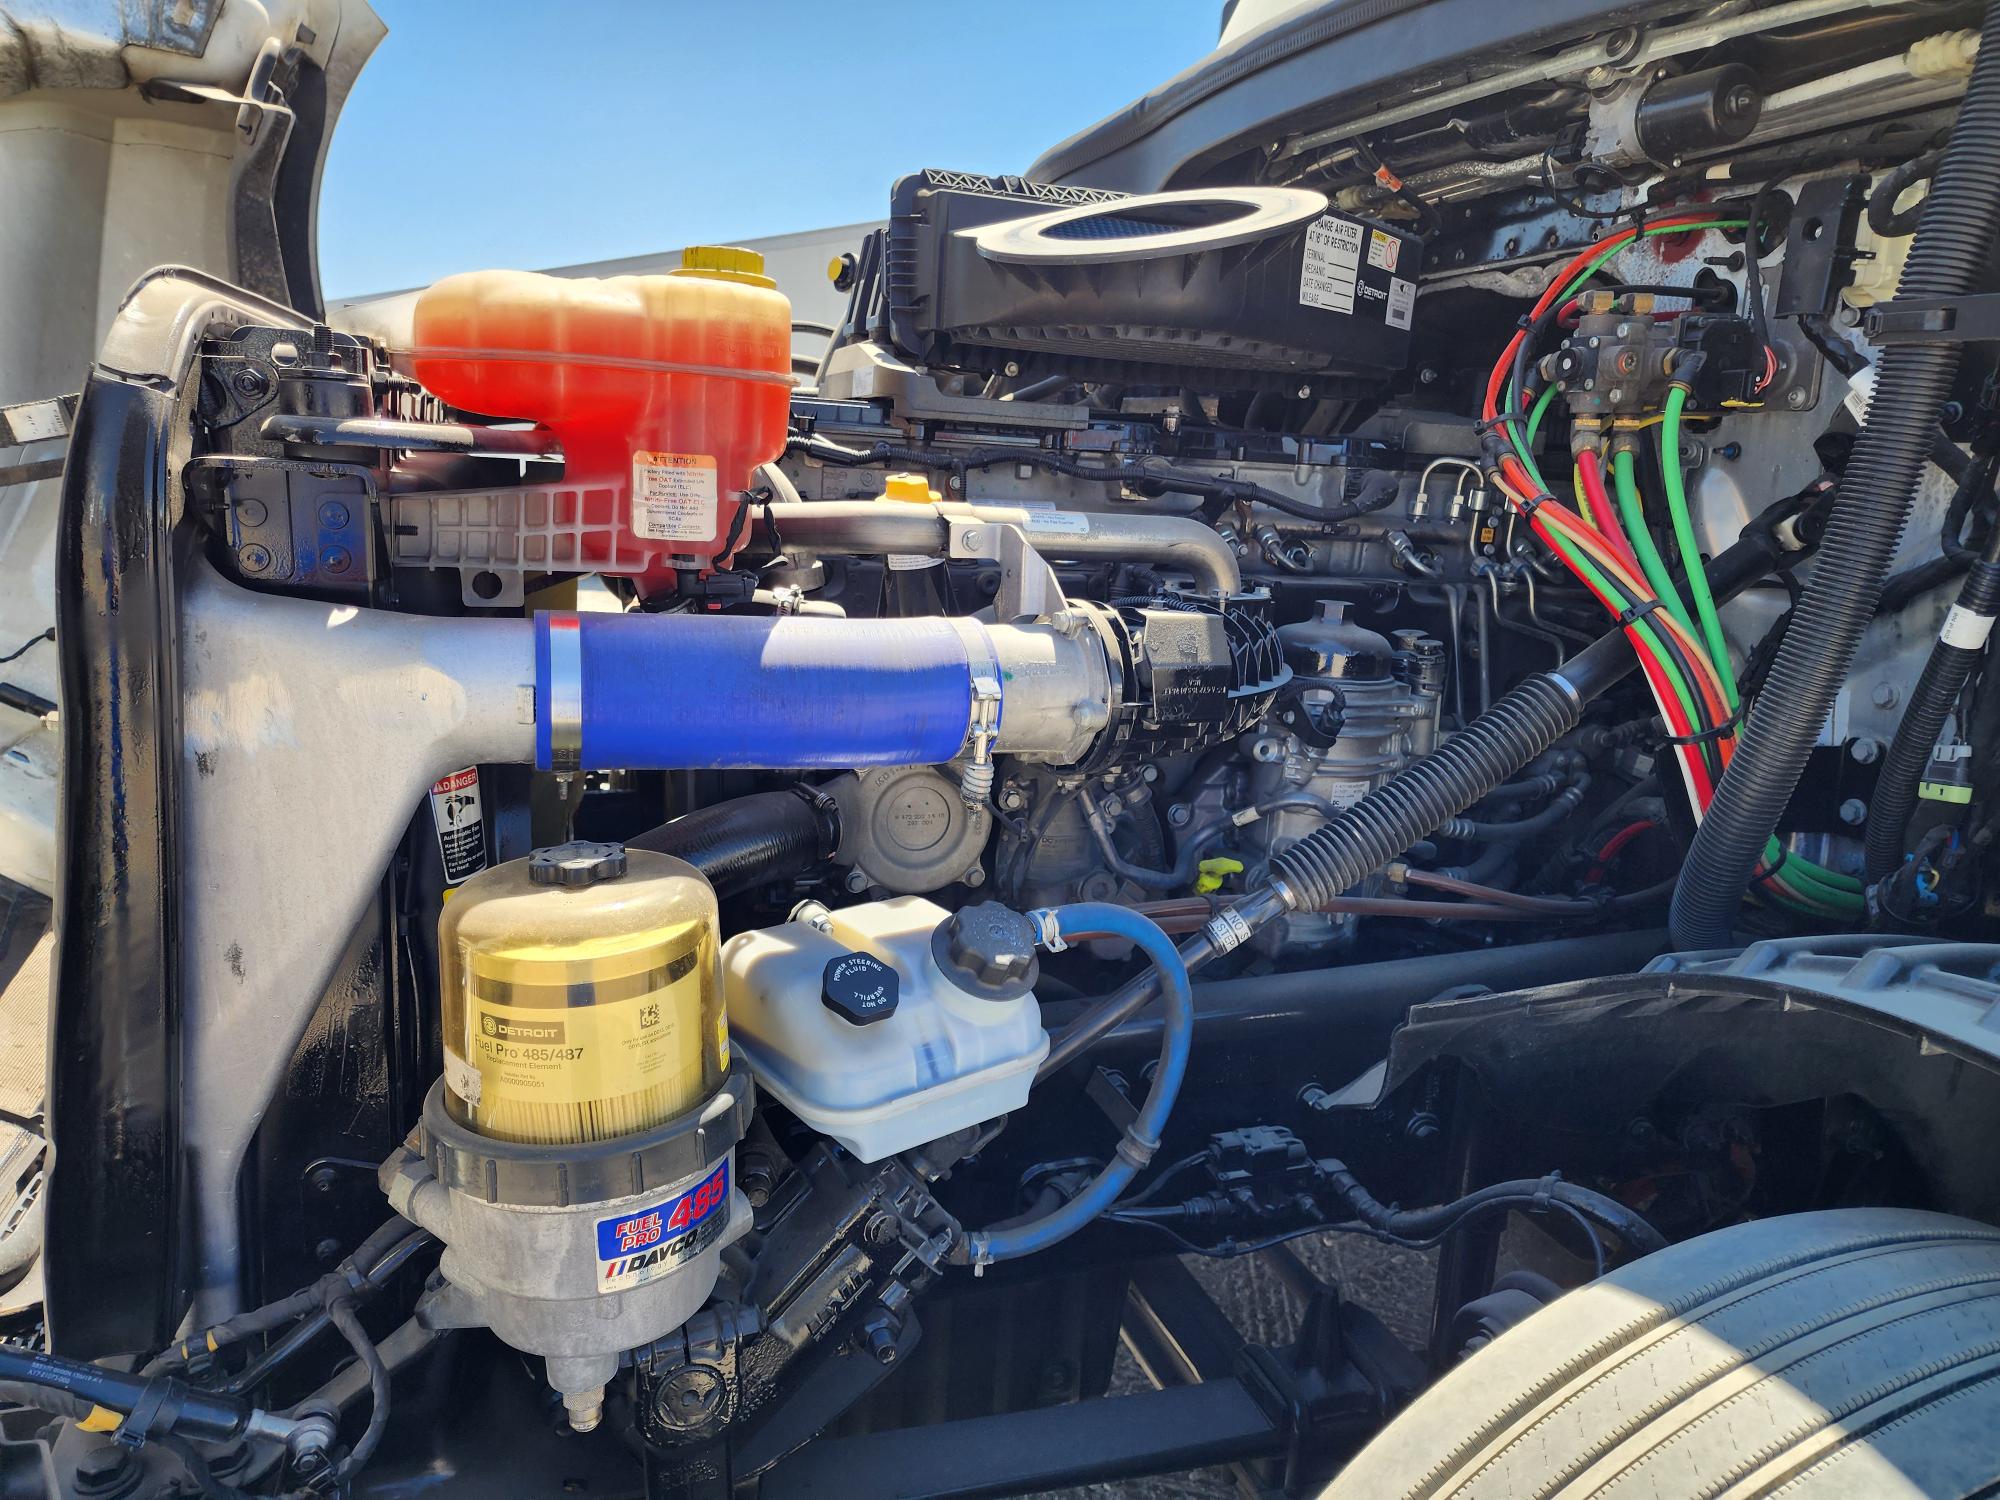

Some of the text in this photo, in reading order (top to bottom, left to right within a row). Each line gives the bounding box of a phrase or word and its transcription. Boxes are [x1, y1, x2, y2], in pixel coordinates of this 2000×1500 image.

[1335, 224, 1344, 234] AIR
[1344, 225, 1358, 239] FILTER
[1331, 237, 1359, 253] RESTRICTION
[1303, 277, 1313, 288] DATE
[1364, 286, 1388, 300] DETROIT
[443, 772, 477, 790] DANGER
[1229, 915, 1244, 930] NO
[1217, 923, 1236, 947] STEP
[833, 958, 883, 982] POWER STEERING
[845, 966, 867, 976] FLUID
[854, 986, 884, 1001] OVERFILL
[878, 996, 887, 1005] DO
[498, 1024, 558, 1038] DETROIT
[475, 1035, 584, 1061] Fuel Pro 485/487
[667, 1168, 724, 1232] 485
[616, 1212, 662, 1238] FUEL
[621, 1226, 662, 1252] PRO
[627, 1228, 698, 1273] DAVCO
